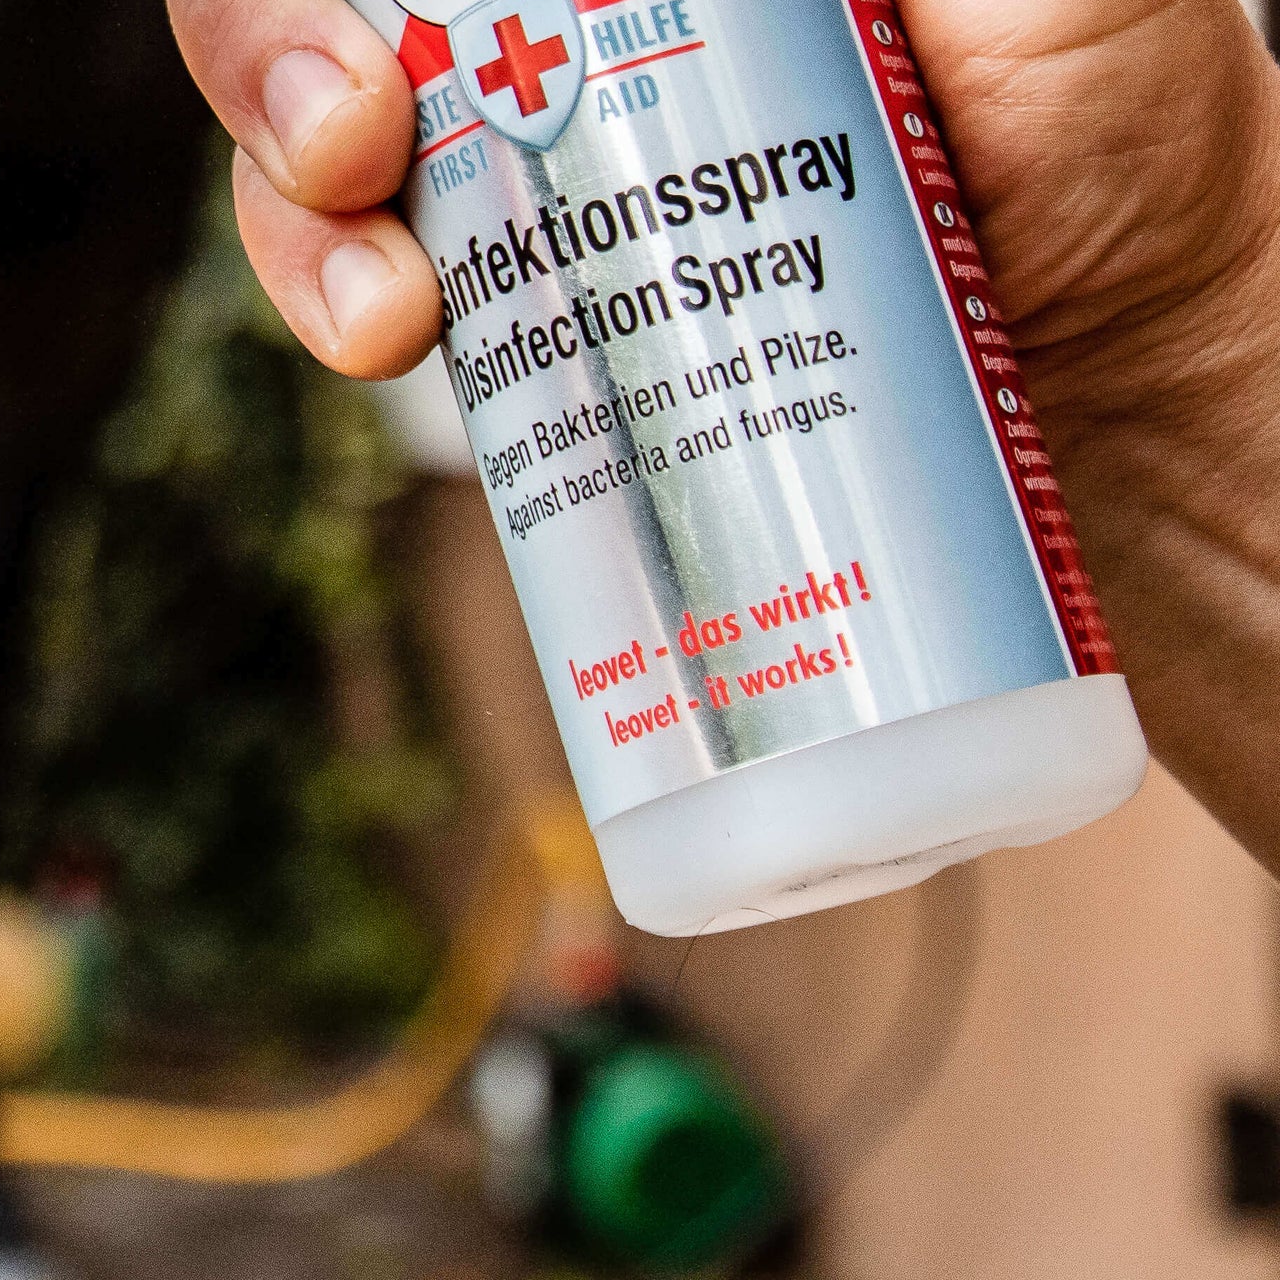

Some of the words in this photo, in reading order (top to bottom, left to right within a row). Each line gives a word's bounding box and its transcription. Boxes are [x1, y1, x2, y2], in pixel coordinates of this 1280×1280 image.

[418, 84, 462, 142] STE
[428, 137, 490, 198] FIRST
[597, 74, 661, 123] AID
[454, 275, 673, 413] Disinfection
[671, 234, 826, 317] Spray
[483, 438, 534, 491] Gegen
[532, 377, 677, 460] Bakterien
[684, 346, 754, 399] und
[761, 328, 858, 376] Pilze.
[505, 483, 564, 541] Against
[563, 444, 670, 507] bacteria
[676, 416, 733, 463] and
[739, 390, 857, 442] fungus.
[568, 640, 648, 702] leovet
[678, 610, 743, 659] das
[604, 693, 681, 748] leovet
[704, 675, 732, 711] it
